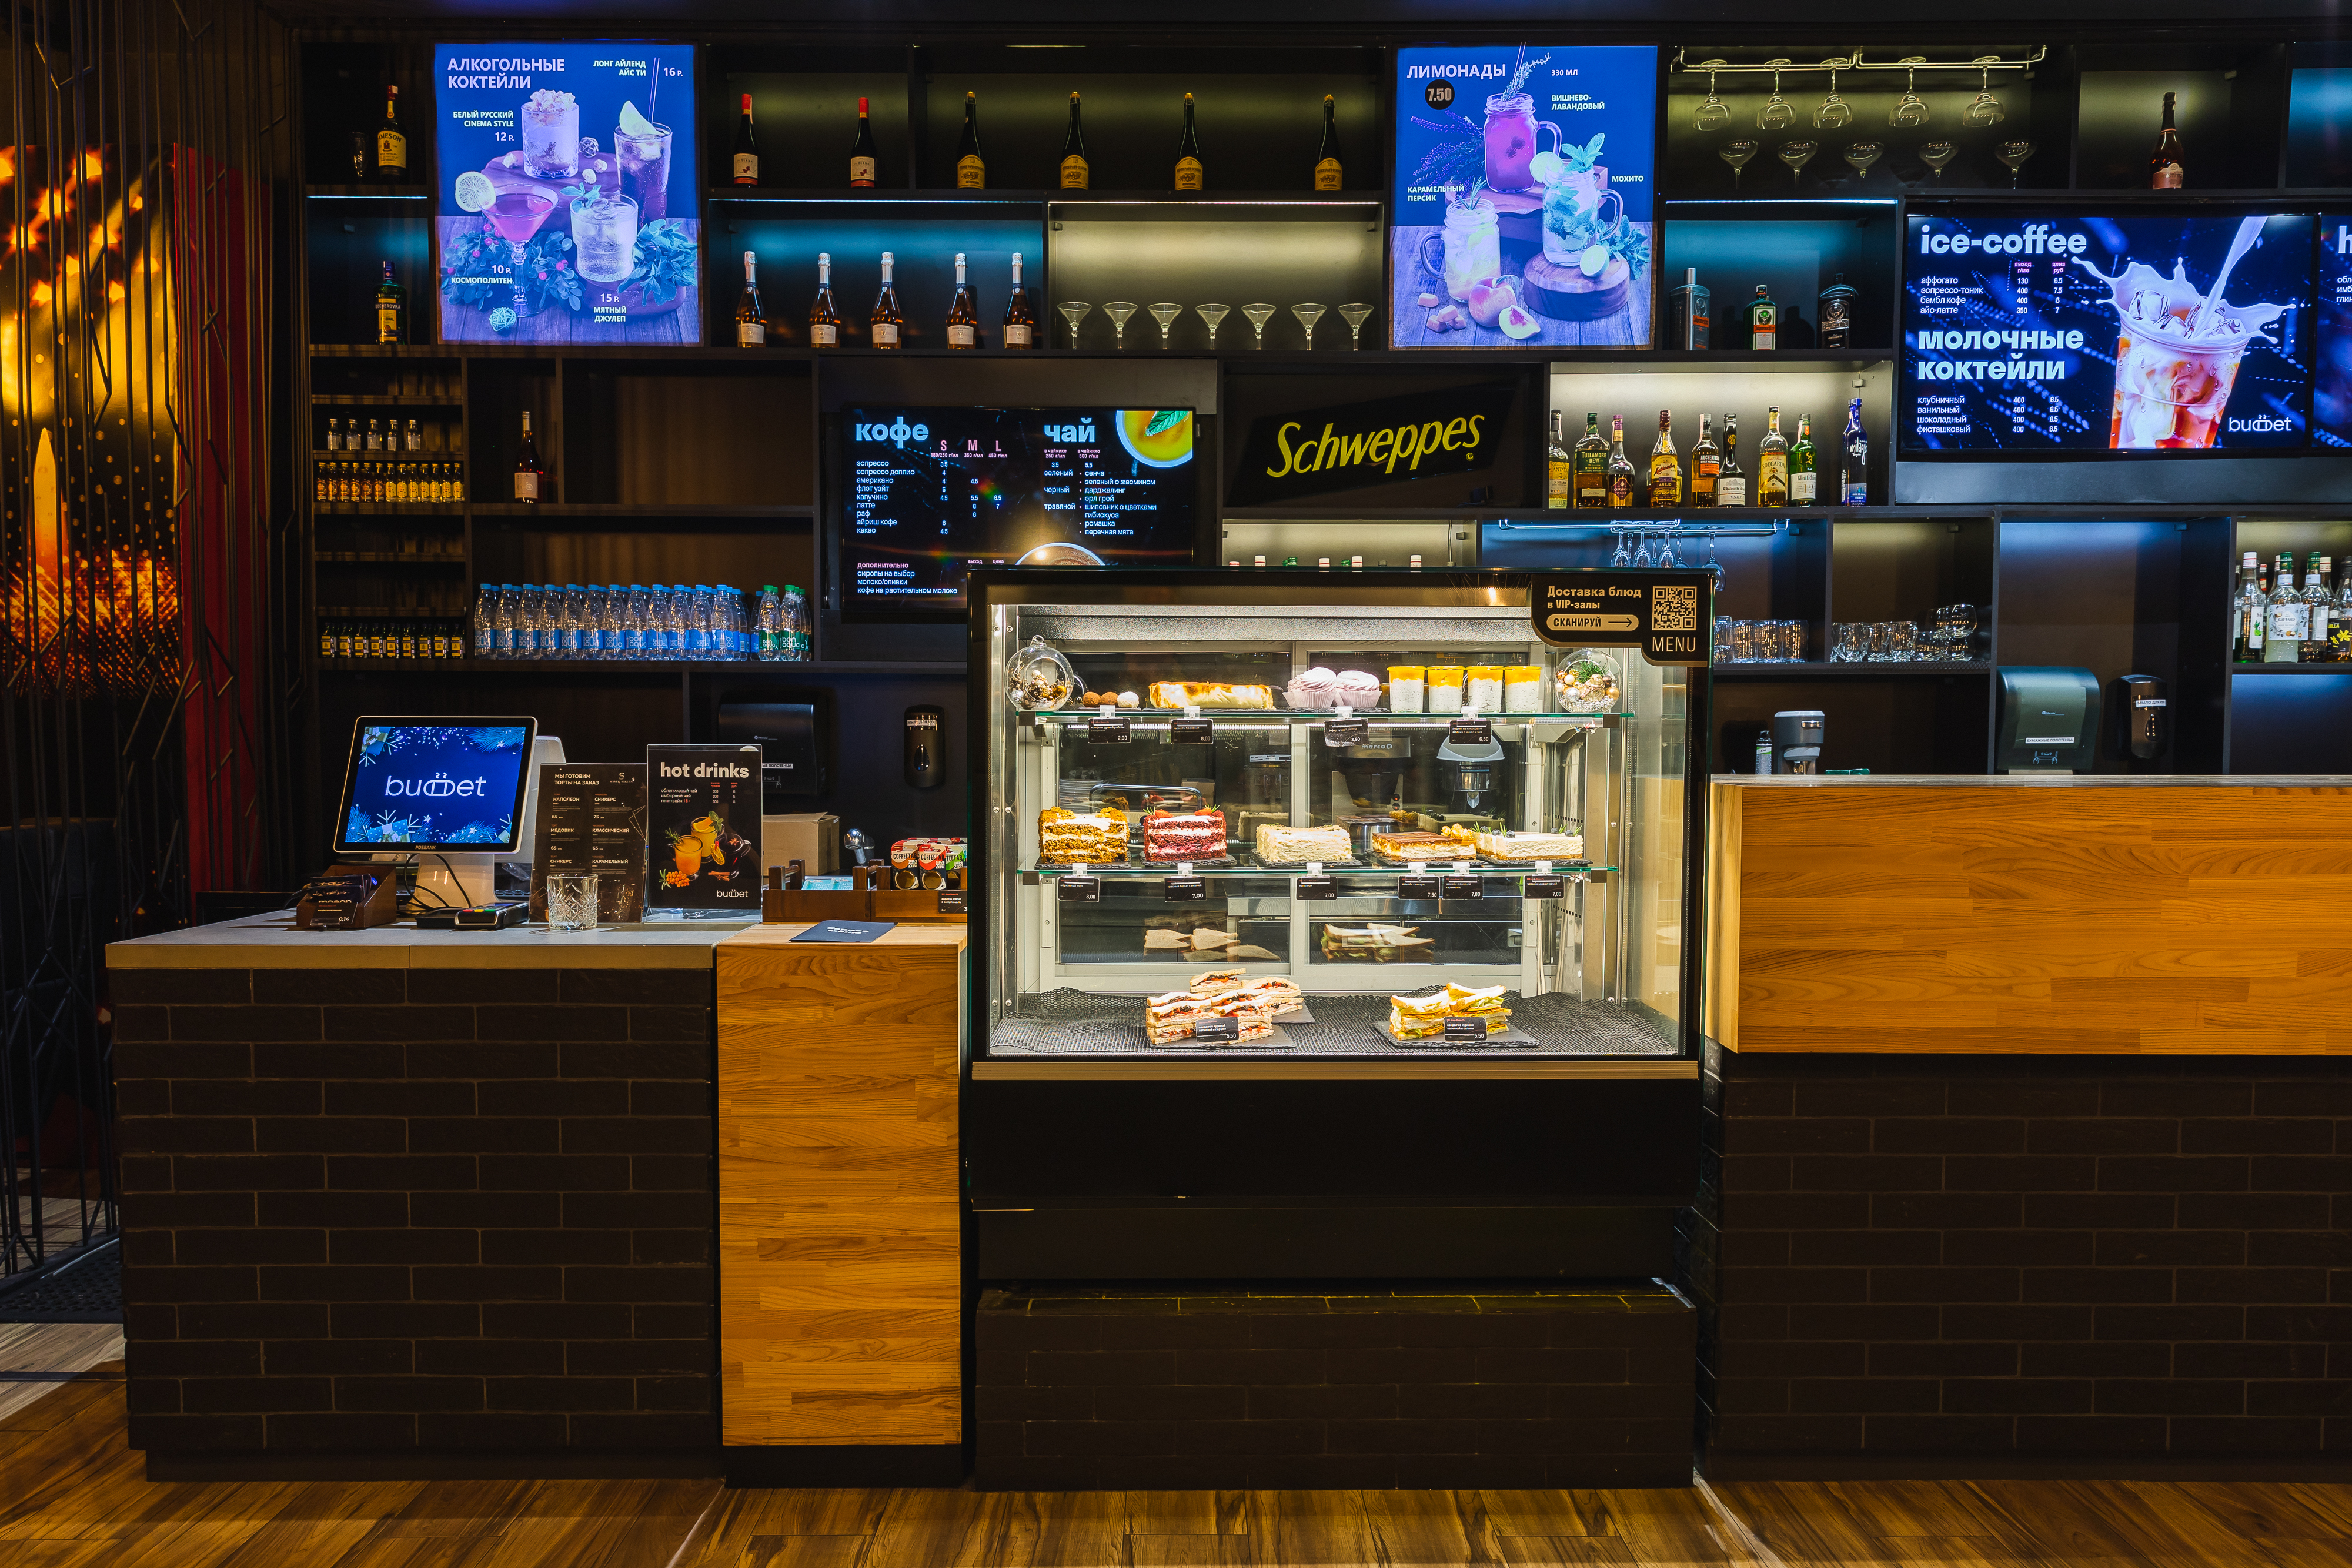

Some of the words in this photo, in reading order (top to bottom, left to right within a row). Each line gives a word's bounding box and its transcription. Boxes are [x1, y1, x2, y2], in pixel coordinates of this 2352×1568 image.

[447, 58, 565, 72] АЛКОГОЛЬНЫЕ
[593, 59, 613, 68] ЛОНГ
[615, 59, 646, 69] АЙЛЕНД
[619, 68, 634, 76] АЙС
[663, 67, 676, 76] 16
[1407, 63, 1506, 80] ЛИМОНАДЫ
[448, 75, 531, 89] КОКТЕЙЛИ
[1428, 88, 1452, 102] 7.50
[1551, 102, 1605, 111] ЛАВАНДОВЫЙ
[453, 111, 479, 119] БЕЛЫЙ
[480, 111, 513, 119] РУССКИЙ
[495, 132, 506, 141] 12
[1408, 184, 1465, 193] КАРАМЕЛЬНЫЙ
[1921, 225, 2087, 255] ice-coffee
[492, 265, 503, 274] 10
[451, 276, 512, 285] КОСМОПОЛИТЕН
[1920, 275, 1959, 287] аффогато
[1920, 287, 1984, 296] эспрессо-тоник
[600, 293, 612, 303] 15
[1920, 295, 1946, 304] бамбл
[1946, 297, 1966, 306] кофе
[594, 305, 627, 313] МЯТНЫЙ
[1920, 306, 1959, 314] айс-латте
[594, 315, 626, 323] ДЖУЛЕП
[1919, 330, 2084, 350] молочные
[1918, 352, 2065, 380] коктейли
[1917, 395, 1965, 407] клубничный
[1917, 406, 1960, 414] ванильный
[1917, 415, 1966, 424] шоколадный
[856, 416, 929, 449] кофе
[1044, 417, 1095, 442] чай
[1917, 425, 1971, 435] фисташковый
[941, 440, 947, 452] S
[968, 440, 978, 451] M
[995, 440, 1001, 452] L
[1267, 414, 1485, 477] Schweppes
[856, 485, 873, 493] флэт
[1044, 486, 1070, 494] черный
[1803, 483, 1814, 493] 12
[1098, 495, 1114, 503] грей
[1044, 503, 1075, 511] травяной
[857, 510, 870, 519] раф
[857, 519, 880, 527] айриш
[881, 519, 897, 527] кофе
[894, 570, 915, 579] выбор
[857, 587, 875, 595] кофе
[1548, 586, 1605, 597] Доставка
[1608, 586, 1642, 599] блюд
[1556, 600, 1600, 609] VIP-залы
[1553, 616, 1602, 627] СКАНИРУЙ
[1652, 637, 1696, 653] MENU
[661, 762, 690, 777] hot
[694, 763, 749, 778] drinks
